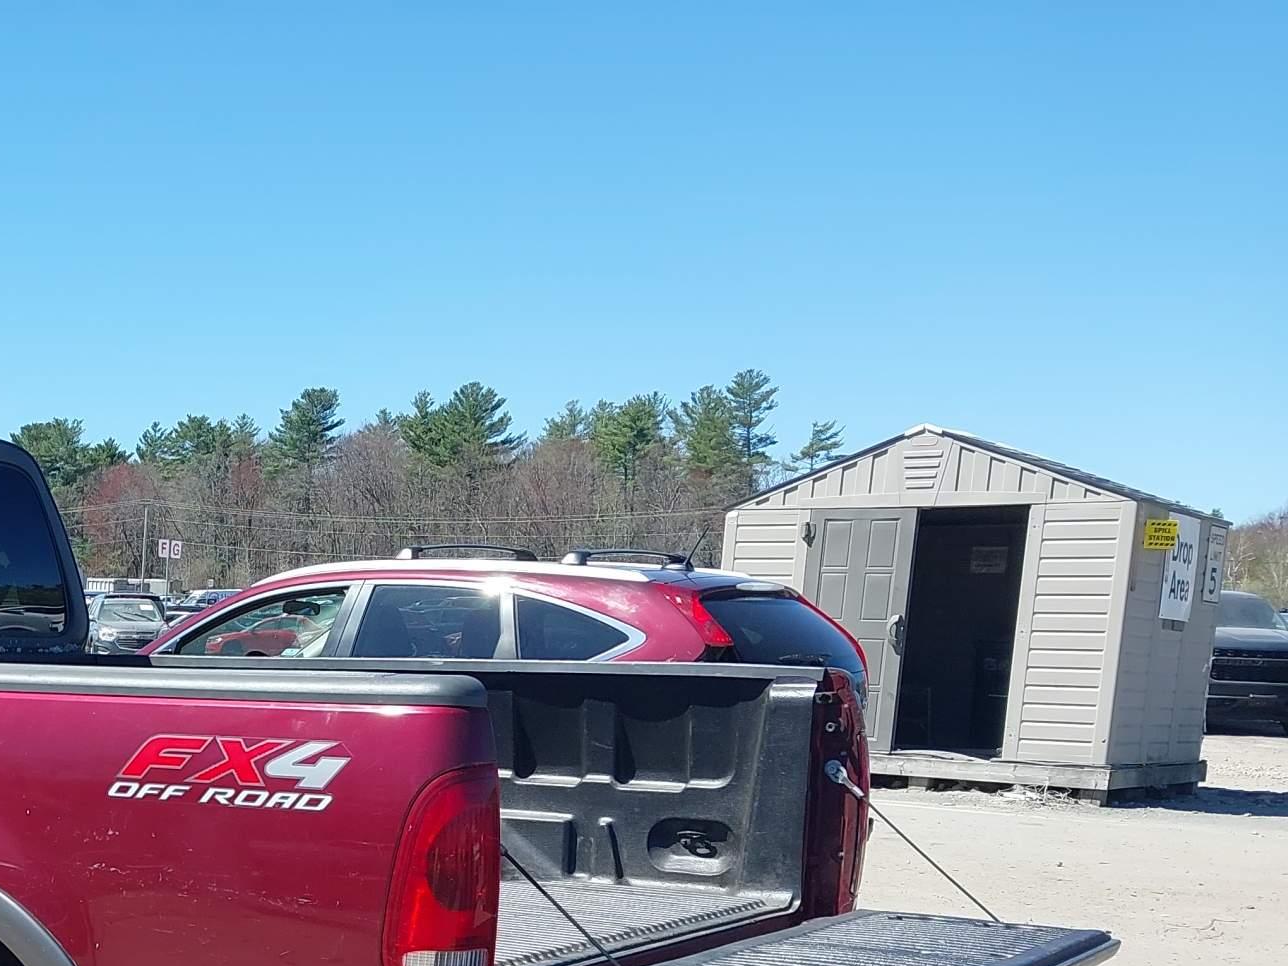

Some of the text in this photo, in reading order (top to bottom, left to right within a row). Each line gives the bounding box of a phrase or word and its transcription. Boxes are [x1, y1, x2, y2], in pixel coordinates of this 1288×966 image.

[160, 542, 180, 556] F G
[1148, 534, 1176, 542] STATION
[1172, 533, 1194, 571] Drop
[1168, 570, 1190, 602] Area
[1208, 567, 1218, 595] 5
[115, 733, 353, 791] FX4
[107, 781, 334, 812] OFF ROAD
